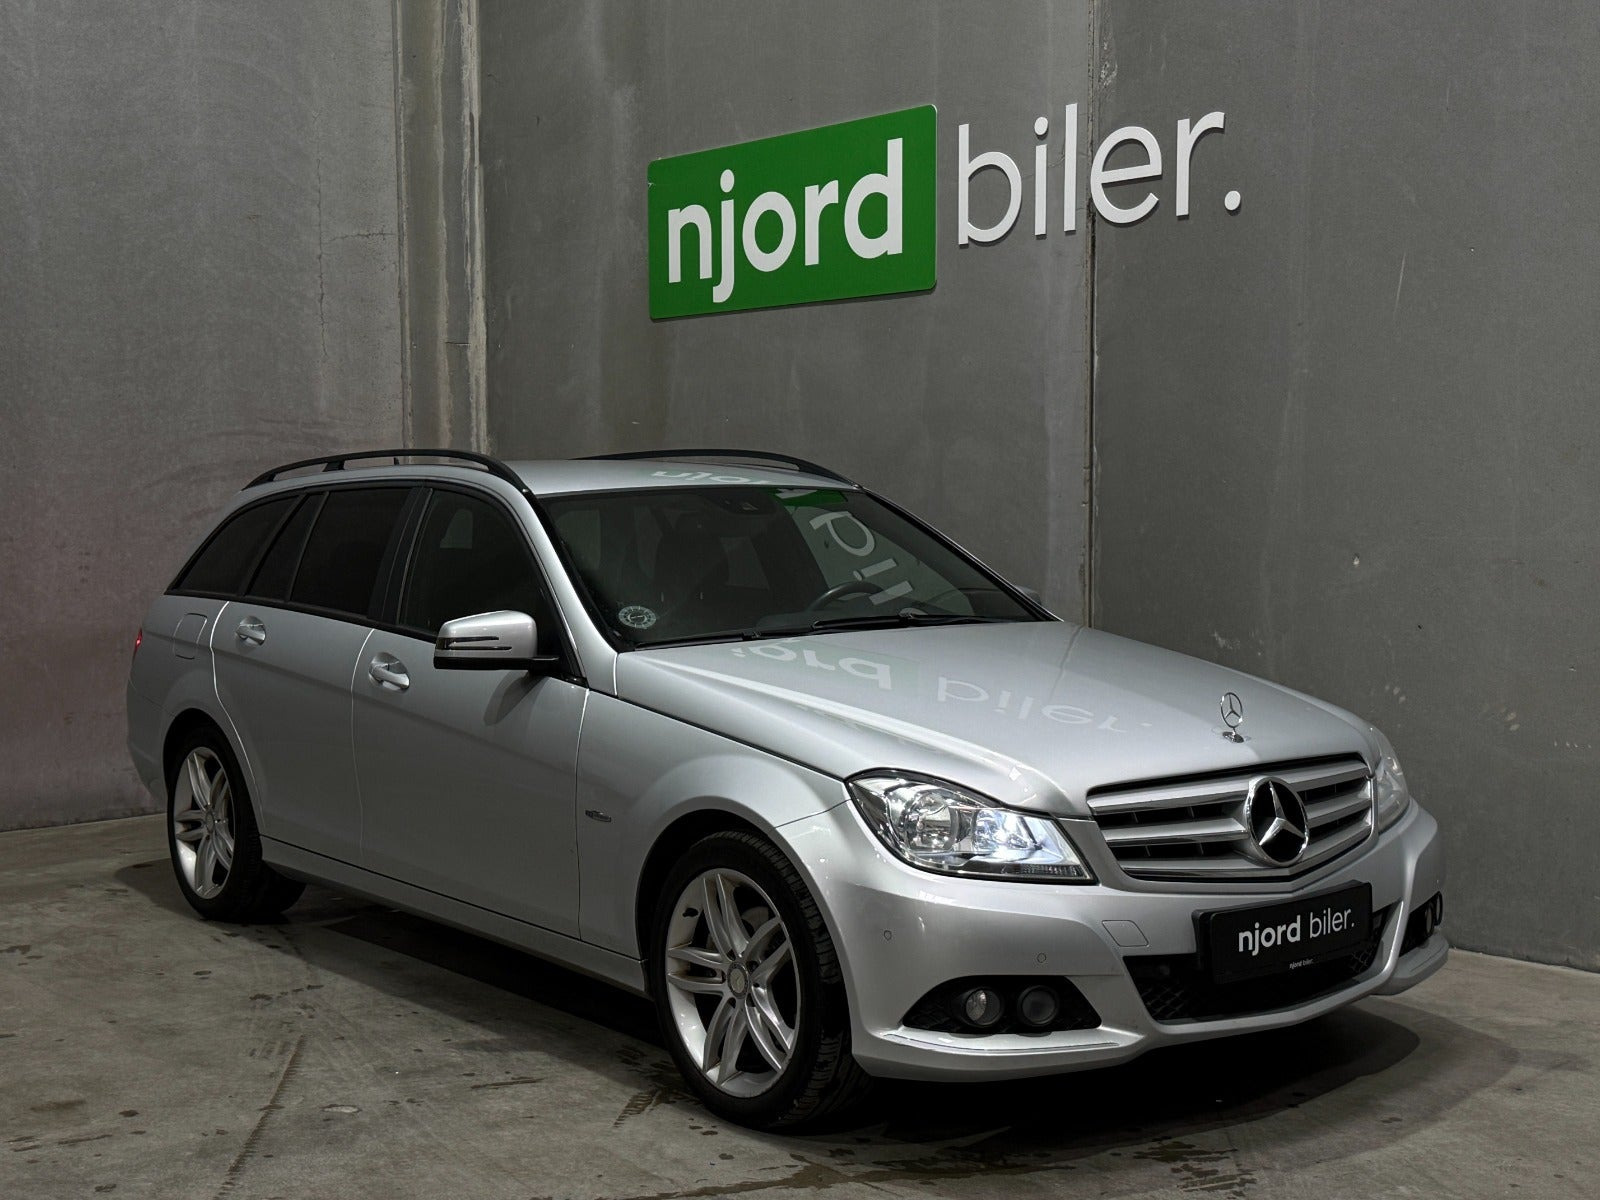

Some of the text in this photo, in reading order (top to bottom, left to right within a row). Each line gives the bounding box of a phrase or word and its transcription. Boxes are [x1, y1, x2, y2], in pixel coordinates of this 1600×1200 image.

[667, 102, 1242, 303] njord biler.
[1238, 907, 1355, 956] njord biler.
